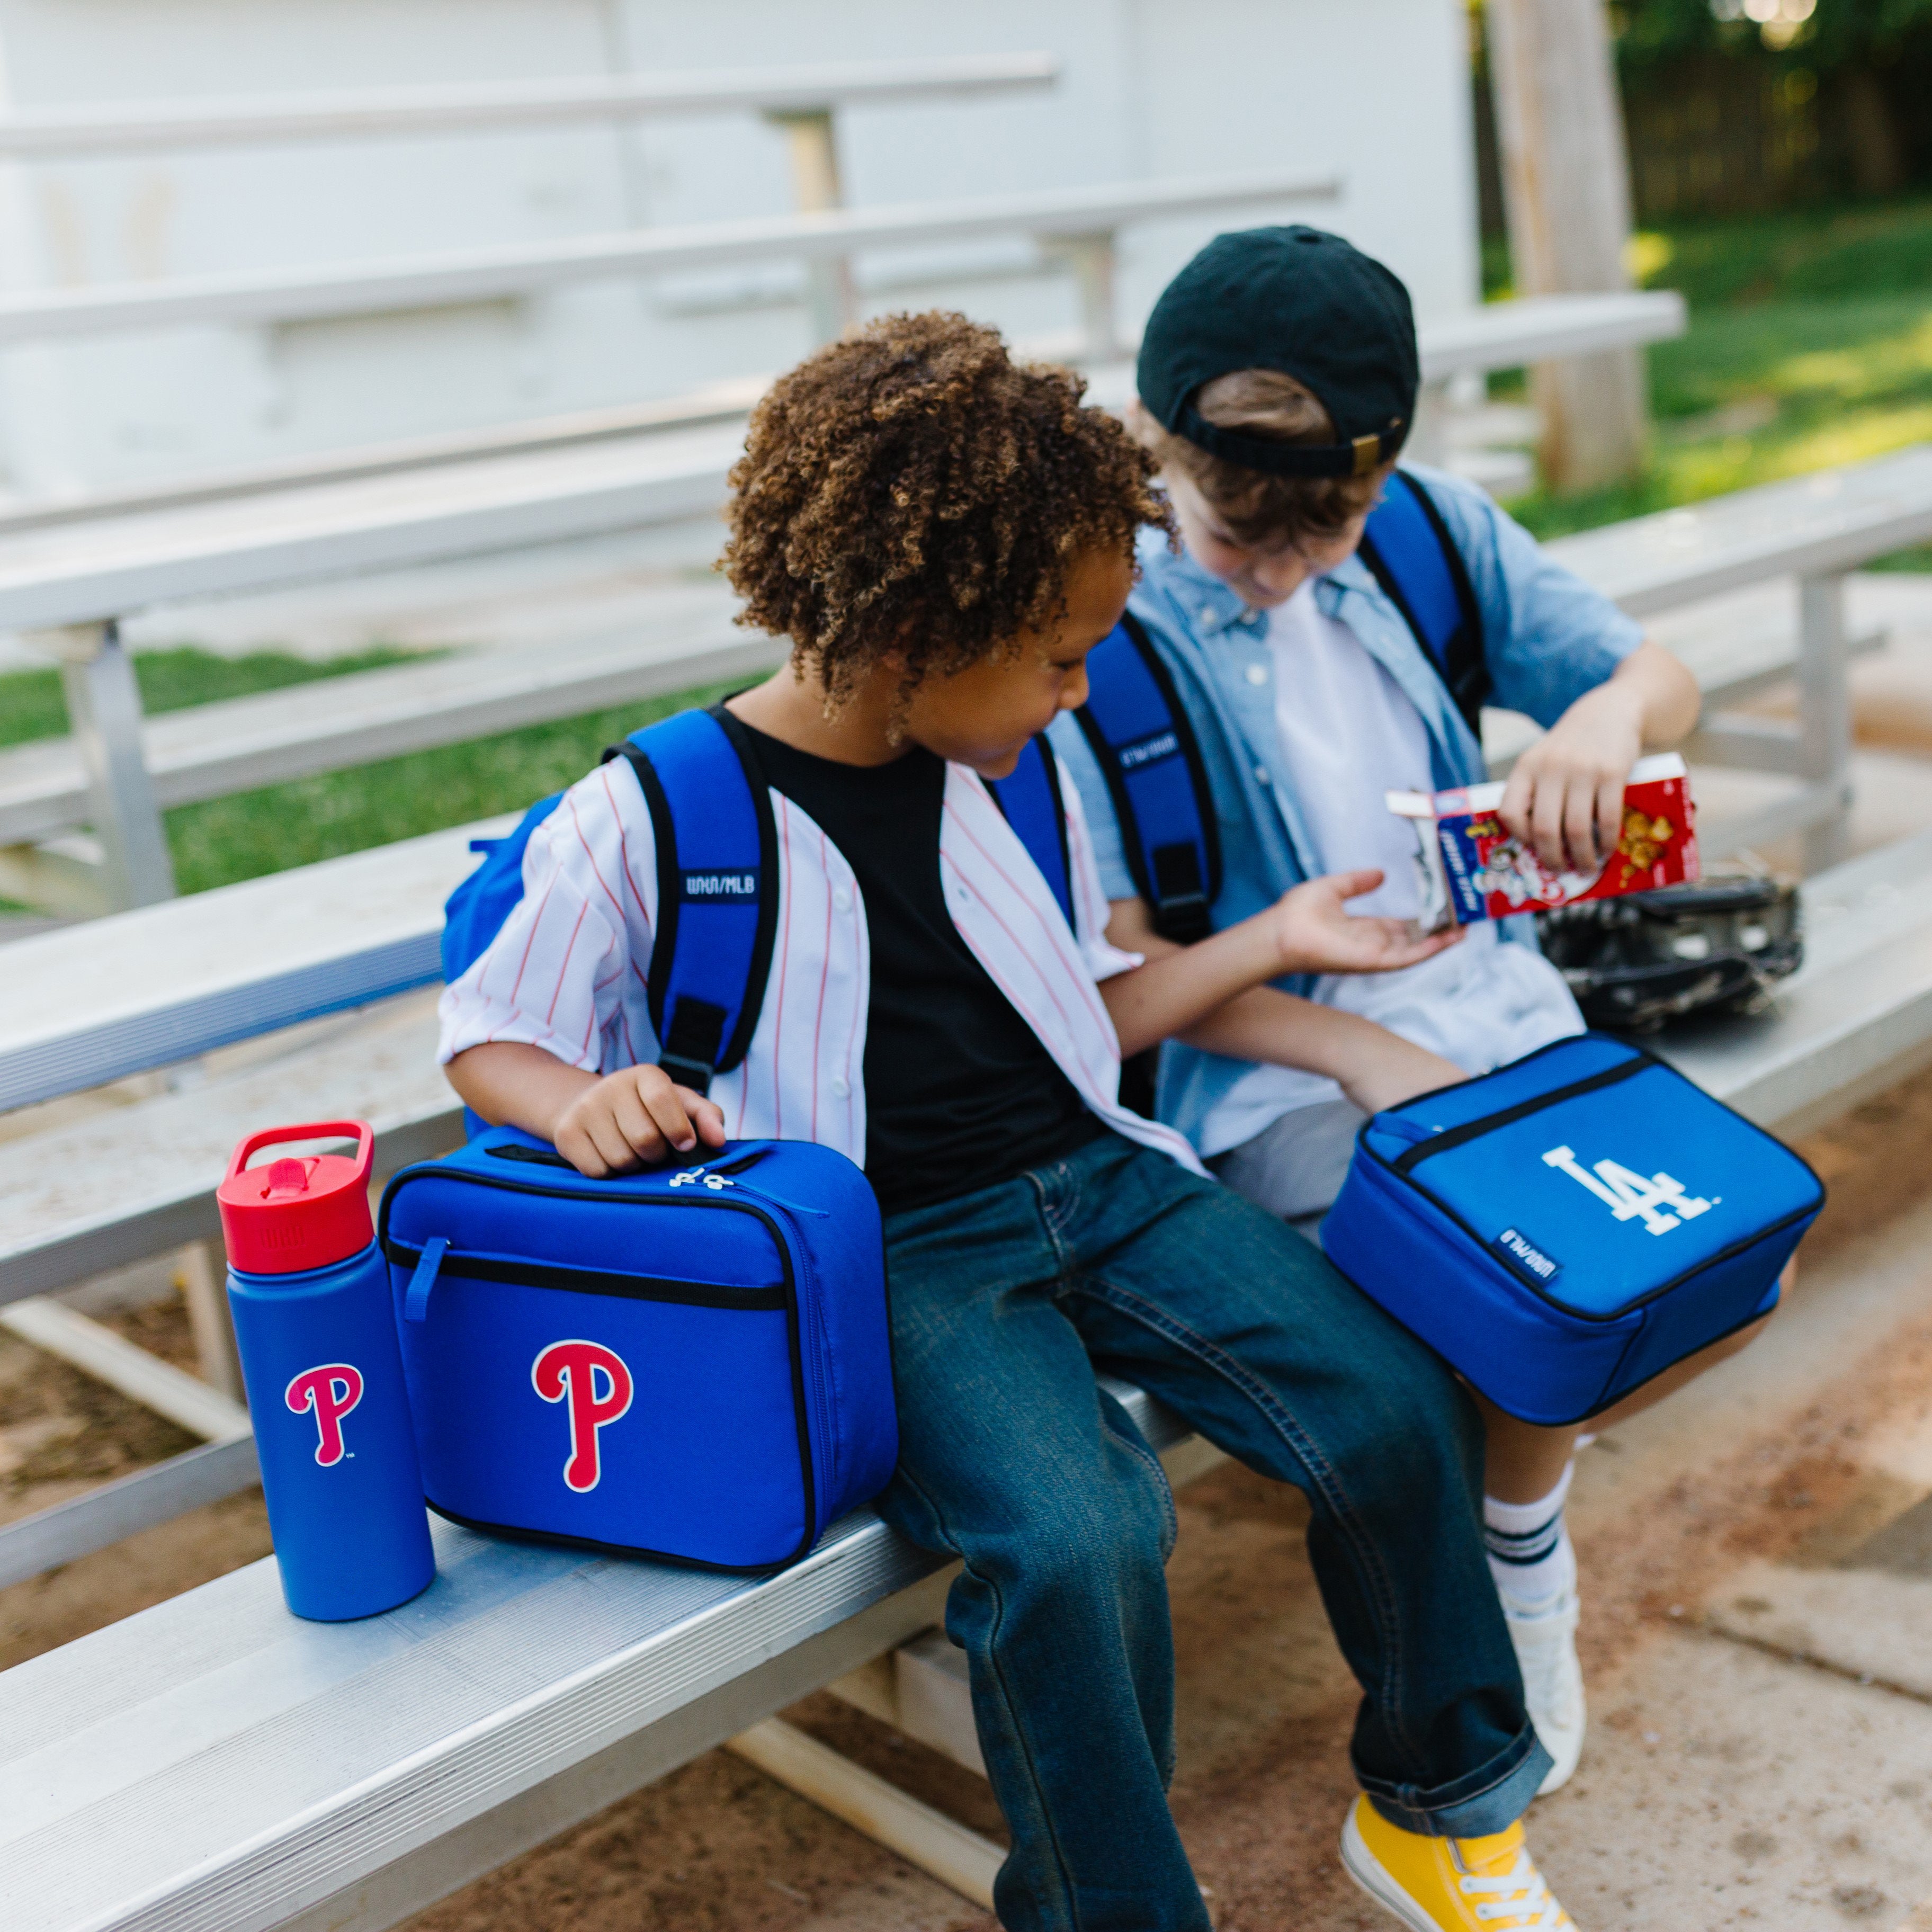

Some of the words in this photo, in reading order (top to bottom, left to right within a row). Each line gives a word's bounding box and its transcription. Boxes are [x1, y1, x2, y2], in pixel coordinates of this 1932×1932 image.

[1542, 1145, 1712, 1237] LA
[284, 1363, 364, 1467] P
[531, 1339, 634, 1493] P
